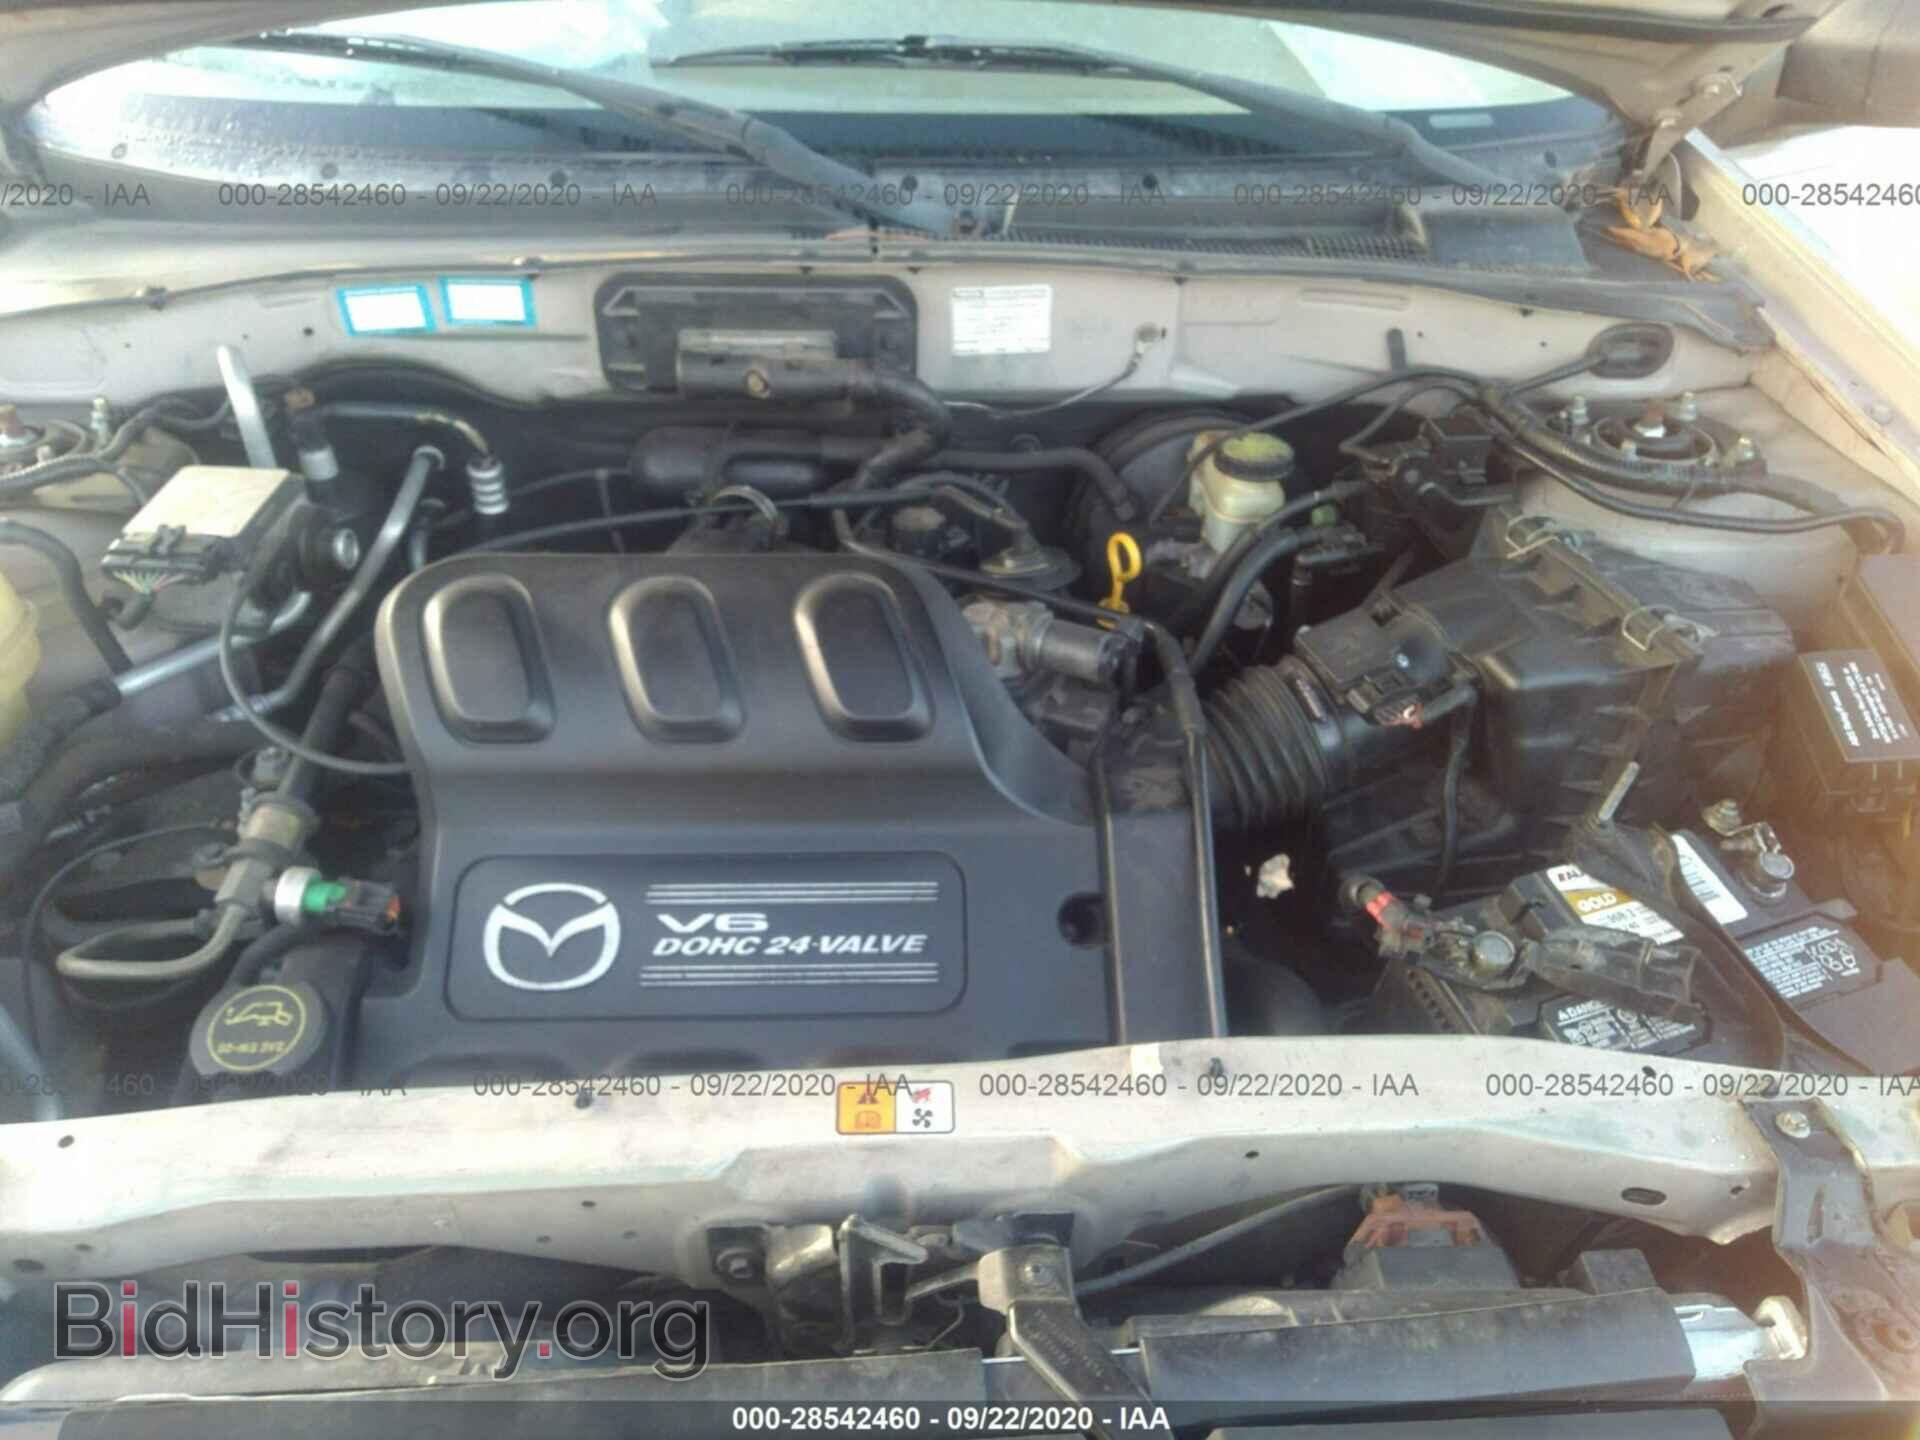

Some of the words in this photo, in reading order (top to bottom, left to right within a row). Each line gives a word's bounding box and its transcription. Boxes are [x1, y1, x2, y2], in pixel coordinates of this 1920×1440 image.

[1576, 891, 1618, 912] GOLD
[656, 912, 769, 934] V6
[652, 936, 761, 957] DOHC
[763, 933, 929, 955] 24-VALVE
